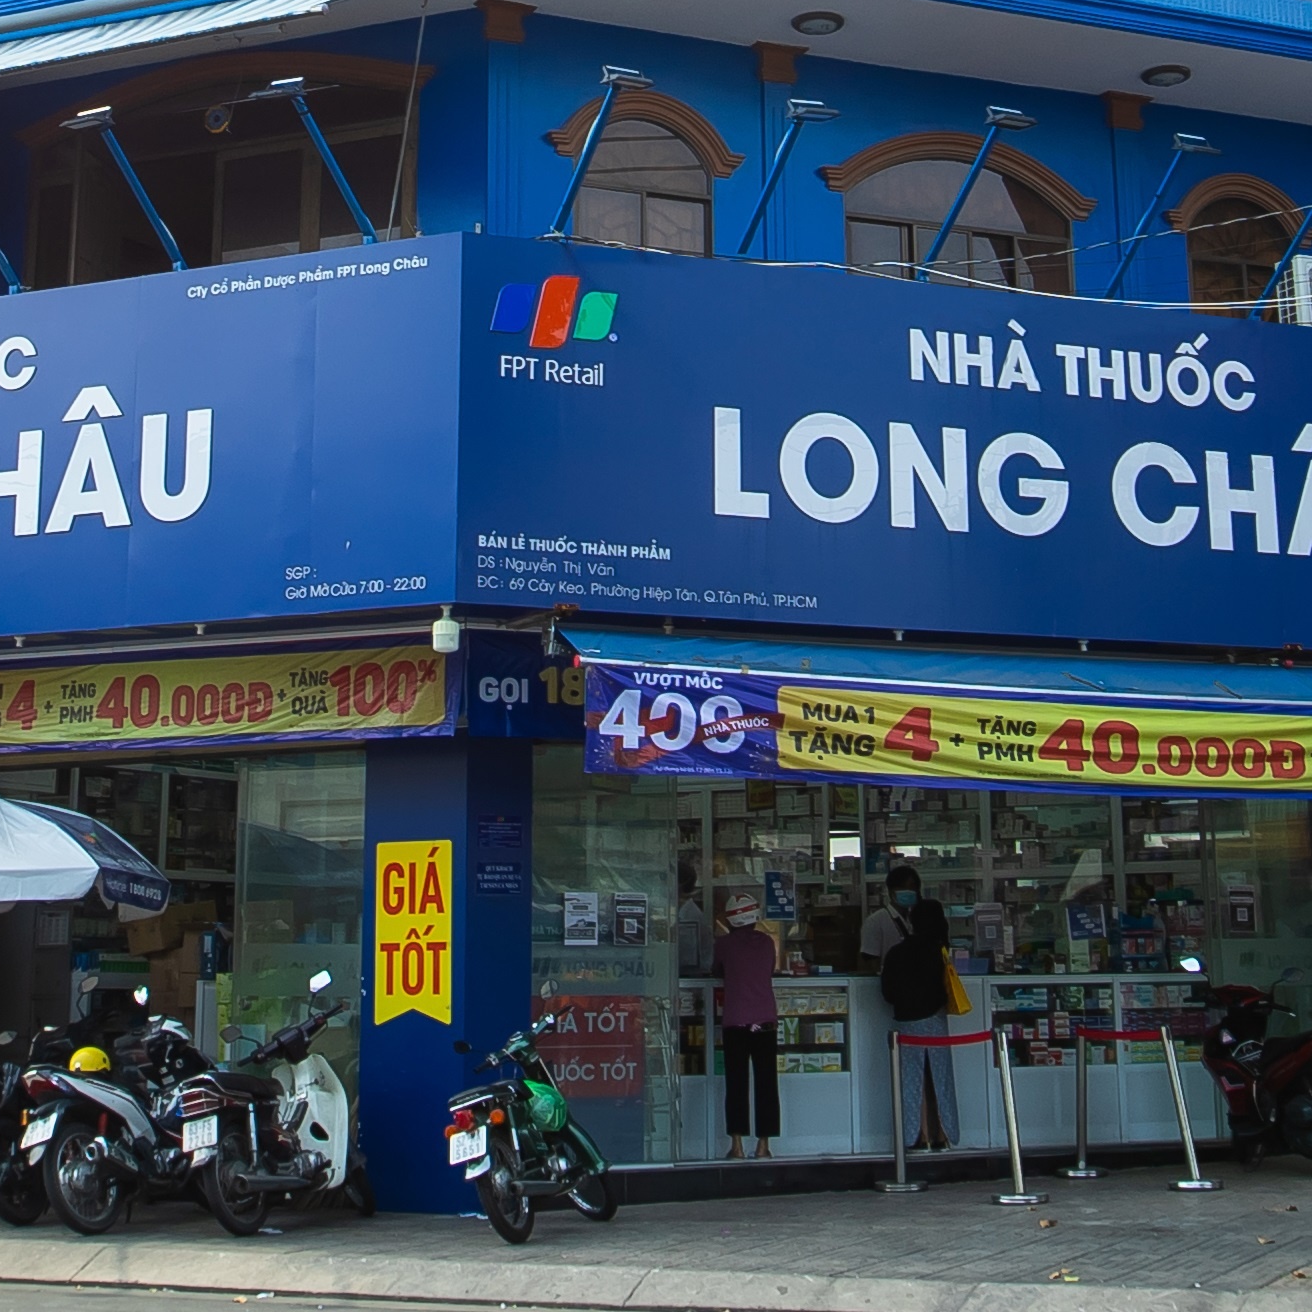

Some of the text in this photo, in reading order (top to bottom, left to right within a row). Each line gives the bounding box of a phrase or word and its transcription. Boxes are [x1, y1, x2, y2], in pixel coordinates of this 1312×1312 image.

[210, 277, 228, 295] Cổ
[230, 274, 261, 292] Phần
[264, 272, 296, 289] Dược
[298, 265, 334, 283] Phẩm
[337, 264, 358, 279] FPT
[359, 261, 390, 276] Long
[393, 256, 428, 271] Châu
[499, 354, 605, 387] FPT Retail
[908, 319, 1257, 413] NHÀ THUỐC
[713, 405, 1070, 538] LONG
[478, 530, 672, 560] BÁN LẺ THUỐC THÀNH PHẨM
[285, 566, 311, 580] SGP
[477, 555, 615, 577] DS Nguyễn Thị Vân
[285, 586, 307, 599] Giờ
[359, 579, 384, 594] 7:00
[393, 576, 427, 592] 22:00
[508, 578, 526, 591] 69
[527, 578, 555, 596] Cây
[590, 581, 640, 601] Phường
[643, 585, 672, 603] Hiệp
[772, 594, 818, 609] TP.HCM
[60, 682, 97, 704] TẶNG
[289, 667, 329, 691] TẶNG
[478, 666, 584, 710] GỌI 18
[633, 671, 723, 690] VƯỢT MỐC
[6, 679, 37, 730] 4
[59, 705, 94, 724] PMH
[96, 673, 274, 730] 40.000Đ
[290, 690, 329, 715] QUÀ
[801, 702, 876, 724] MUA 1
[598, 689, 746, 754] 400
[703, 713, 770, 736] NHÀ THUỐC
[883, 706, 940, 762] 4
[976, 714, 1037, 741] TẶNG
[788, 726, 876, 761] TẶNG
[977, 741, 1035, 763] PMH
[1038, 718, 1307, 780] 40.000Đ
[382, 846, 445, 916] GIÁ
[380, 924, 448, 996] TỐT
[584, 1002, 629, 1033] TỐT
[553, 1054, 637, 1083] UỐC TỐT
